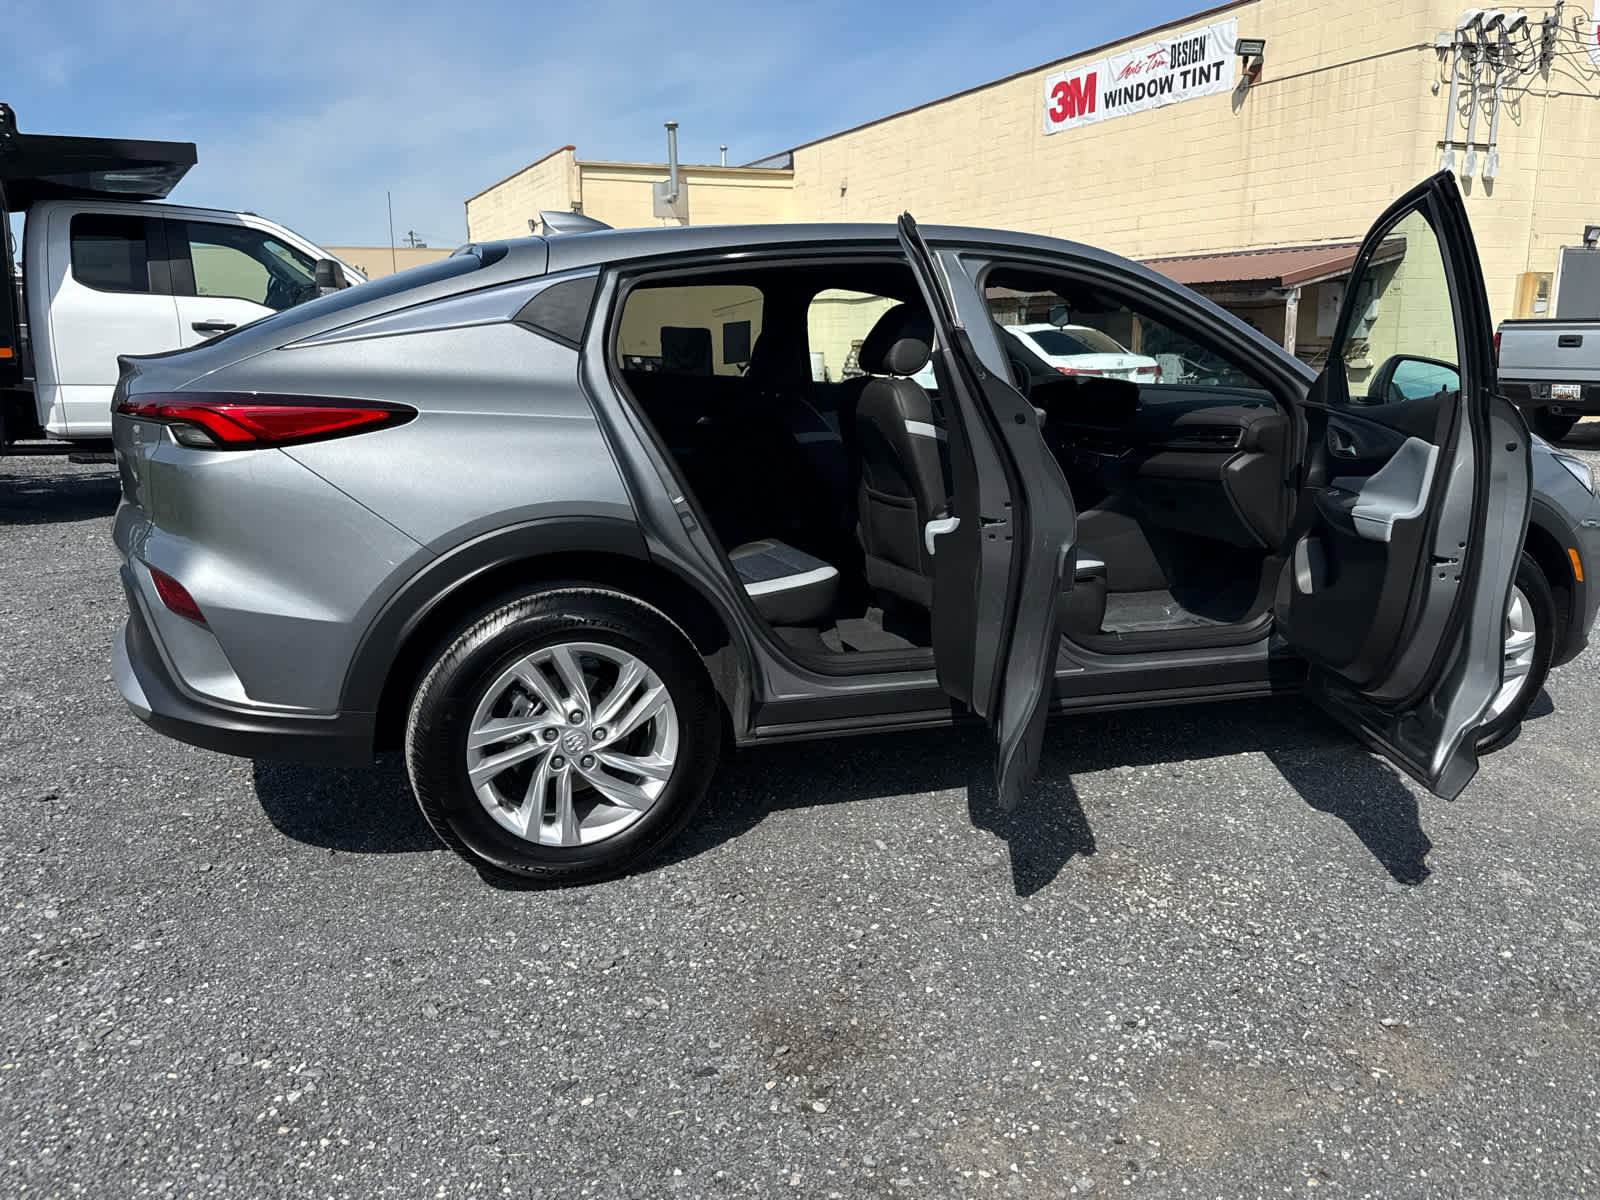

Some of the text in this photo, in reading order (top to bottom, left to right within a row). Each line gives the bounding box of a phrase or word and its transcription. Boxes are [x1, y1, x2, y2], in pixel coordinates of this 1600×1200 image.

[1169, 34, 1206, 70] DESIGN
[1049, 72, 1097, 123] 3M
[1104, 60, 1225, 109] WINDOW TINT
